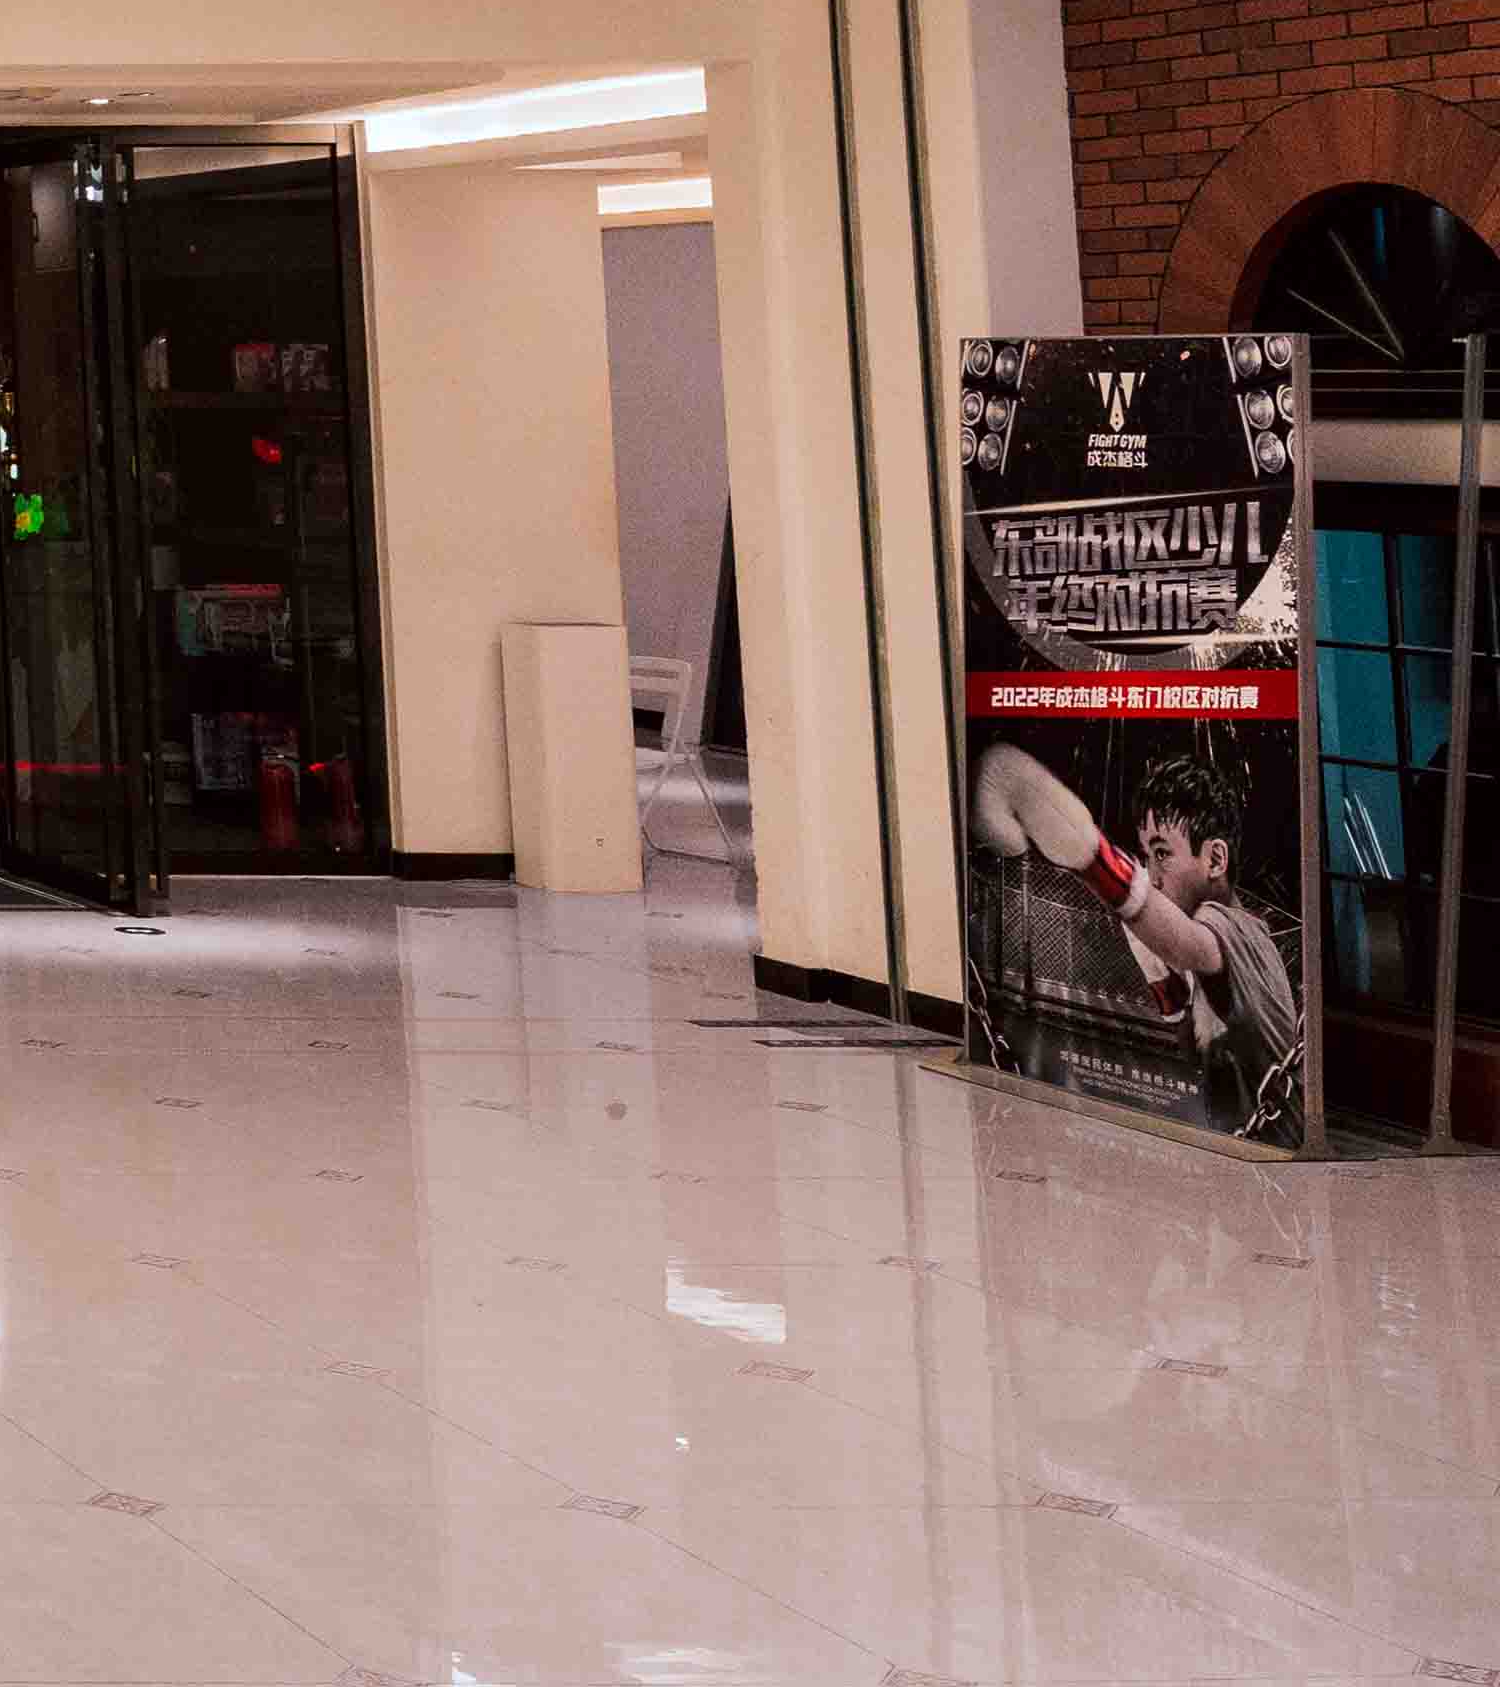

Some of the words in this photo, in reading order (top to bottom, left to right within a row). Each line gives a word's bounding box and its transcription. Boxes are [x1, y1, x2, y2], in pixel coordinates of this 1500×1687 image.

[1087, 432, 1120, 448] FIGHT
[1119, 434, 1148, 450] GYM
[1086, 449, 1149, 468] 成杰格斗
